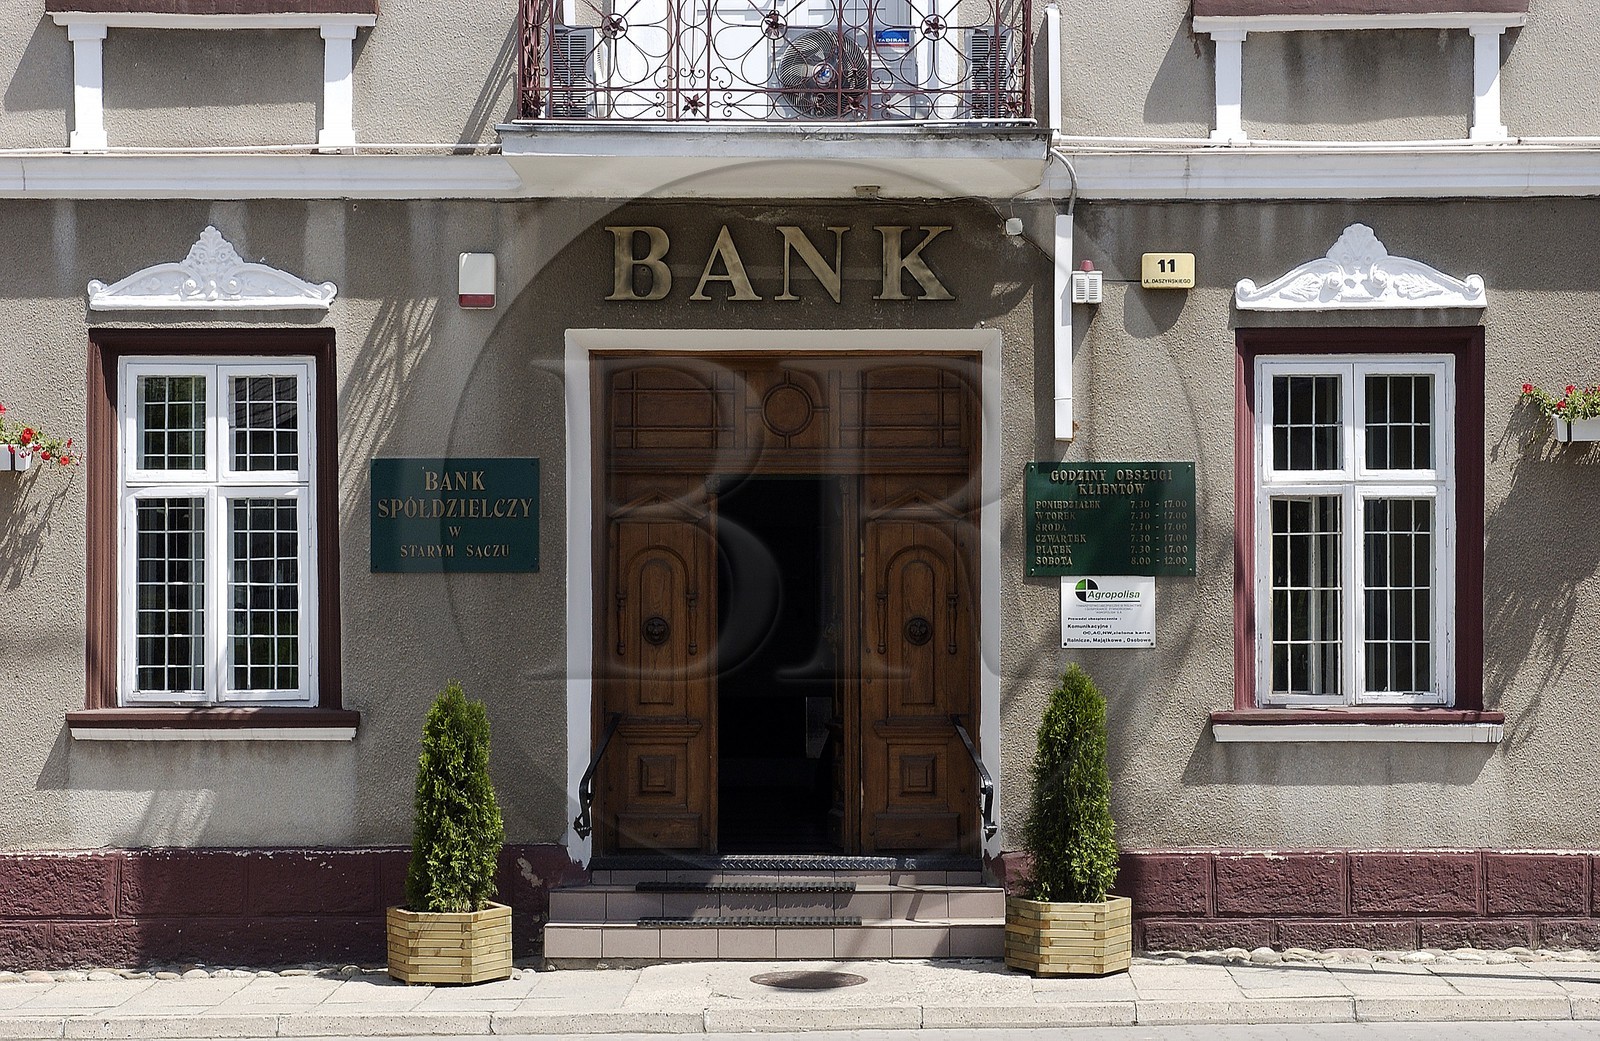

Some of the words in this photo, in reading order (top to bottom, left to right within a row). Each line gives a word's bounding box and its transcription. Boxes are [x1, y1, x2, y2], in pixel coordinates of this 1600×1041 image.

[604, 224, 956, 303] BANK
[1157, 259, 1175, 272] 11
[1051, 469, 1107, 481] GODZINY
[1116, 469, 1173, 481] OBSŁUGI
[425, 471, 485, 491] BANK
[1079, 481, 1146, 495] KLIENTÓW
[377, 496, 532, 518] SPÓŁDZIELCZY
[1130, 500, 1150, 509] 7.30
[1164, 500, 1187, 509] 17.00
[1035, 512, 1076, 520] WTOREK
[1130, 512, 1150, 520] 7.30
[1164, 512, 1187, 520] 17.00
[1035, 522, 1067, 531] ŚRODA
[1130, 523, 1150, 531] 7.30
[1164, 523, 1187, 531] 17.00
[1035, 534, 1087, 543] CZWARTEK
[1130, 534, 1150, 542] 7.30
[1164, 534, 1187, 542] 17.00
[400, 544, 454, 558] STARYM
[466, 544, 510, 559] SĄCZU
[1035, 545, 1072, 555] PIĄTEK
[1130, 545, 1150, 554] 7.30
[1164, 545, 1187, 554] 17.00
[1035, 556, 1073, 565] SOBOTA
[1130, 556, 1150, 565] 8.00
[1164, 556, 1187, 565] 12.00
[1087, 590, 1140, 600] Agropolisa
